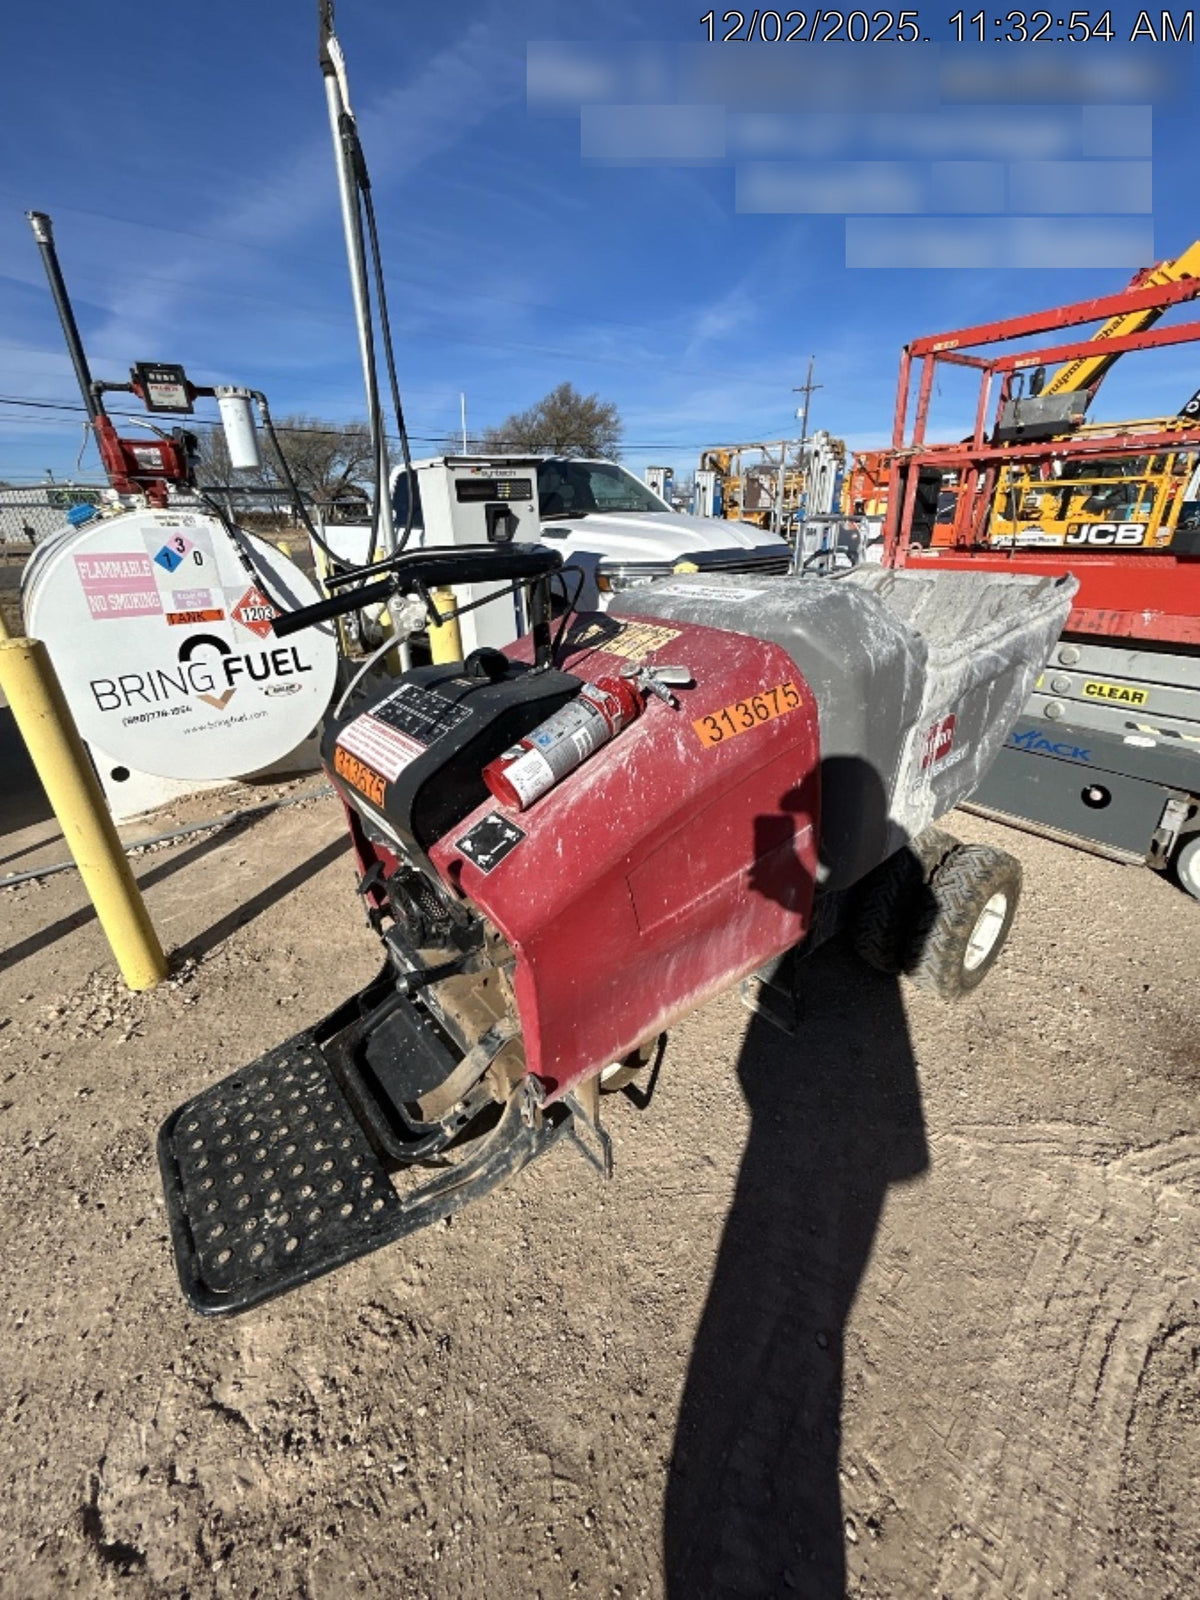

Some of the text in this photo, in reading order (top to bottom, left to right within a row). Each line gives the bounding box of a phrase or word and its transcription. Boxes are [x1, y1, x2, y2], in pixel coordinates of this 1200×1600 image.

[1066, 524, 1145, 545] JCB
[175, 537, 186, 553] 3
[193, 551, 203, 566] 0
[78, 560, 152, 579] FLAMMABLE
[88, 595, 108, 613] NO
[243, 606, 274, 621] 1203
[168, 612, 207, 624] TANK
[90, 647, 312, 711] BRING FUEL
[1085, 683, 1145, 704] CLEAR
[703, 682, 799, 742] 313675
[338, 750, 385, 806] 313675
